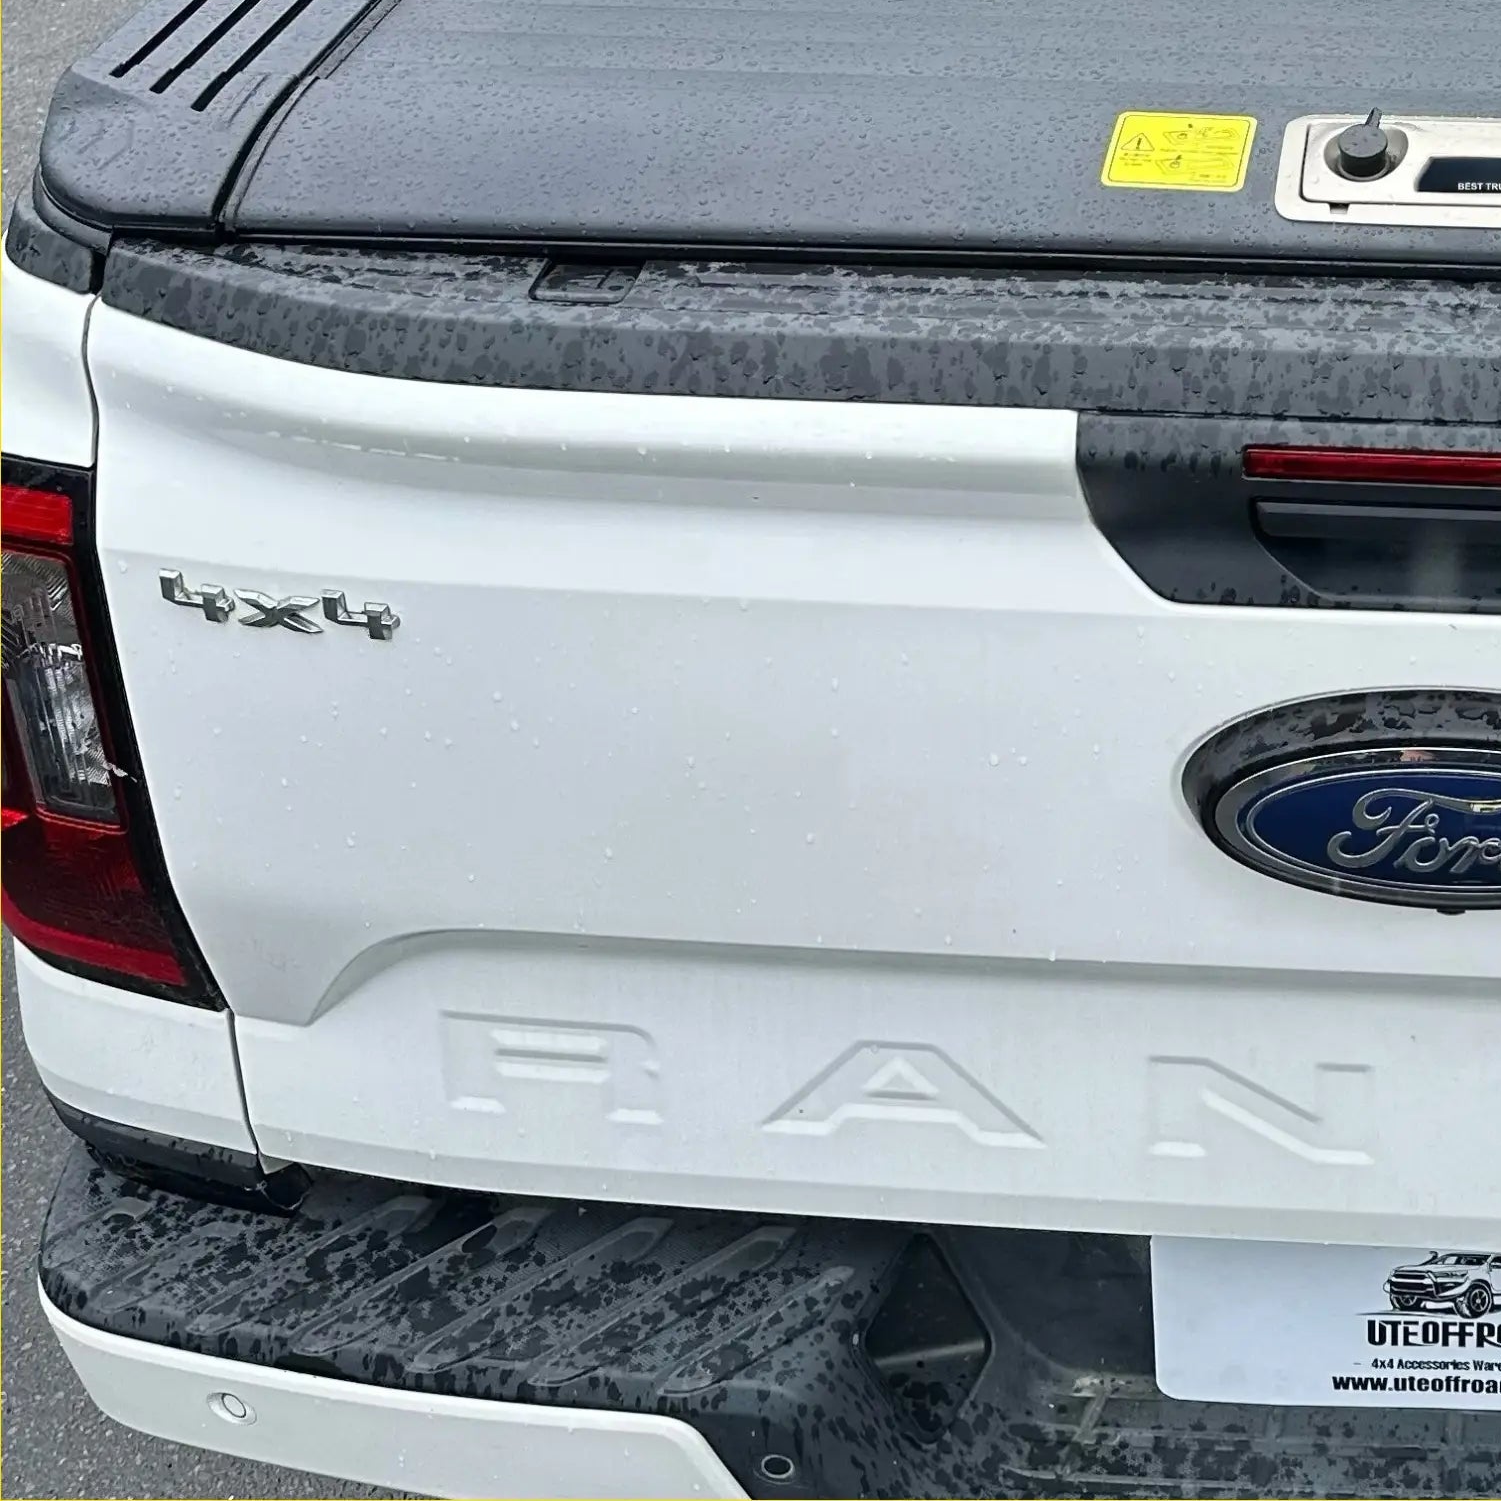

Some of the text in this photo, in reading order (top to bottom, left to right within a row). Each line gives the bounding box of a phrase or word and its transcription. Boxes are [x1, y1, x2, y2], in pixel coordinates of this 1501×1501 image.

[1457, 182, 1483, 191] BEST
[1371, 1358, 1394, 1370] 4x4
[1396, 1358, 1470, 1371] Accessories
